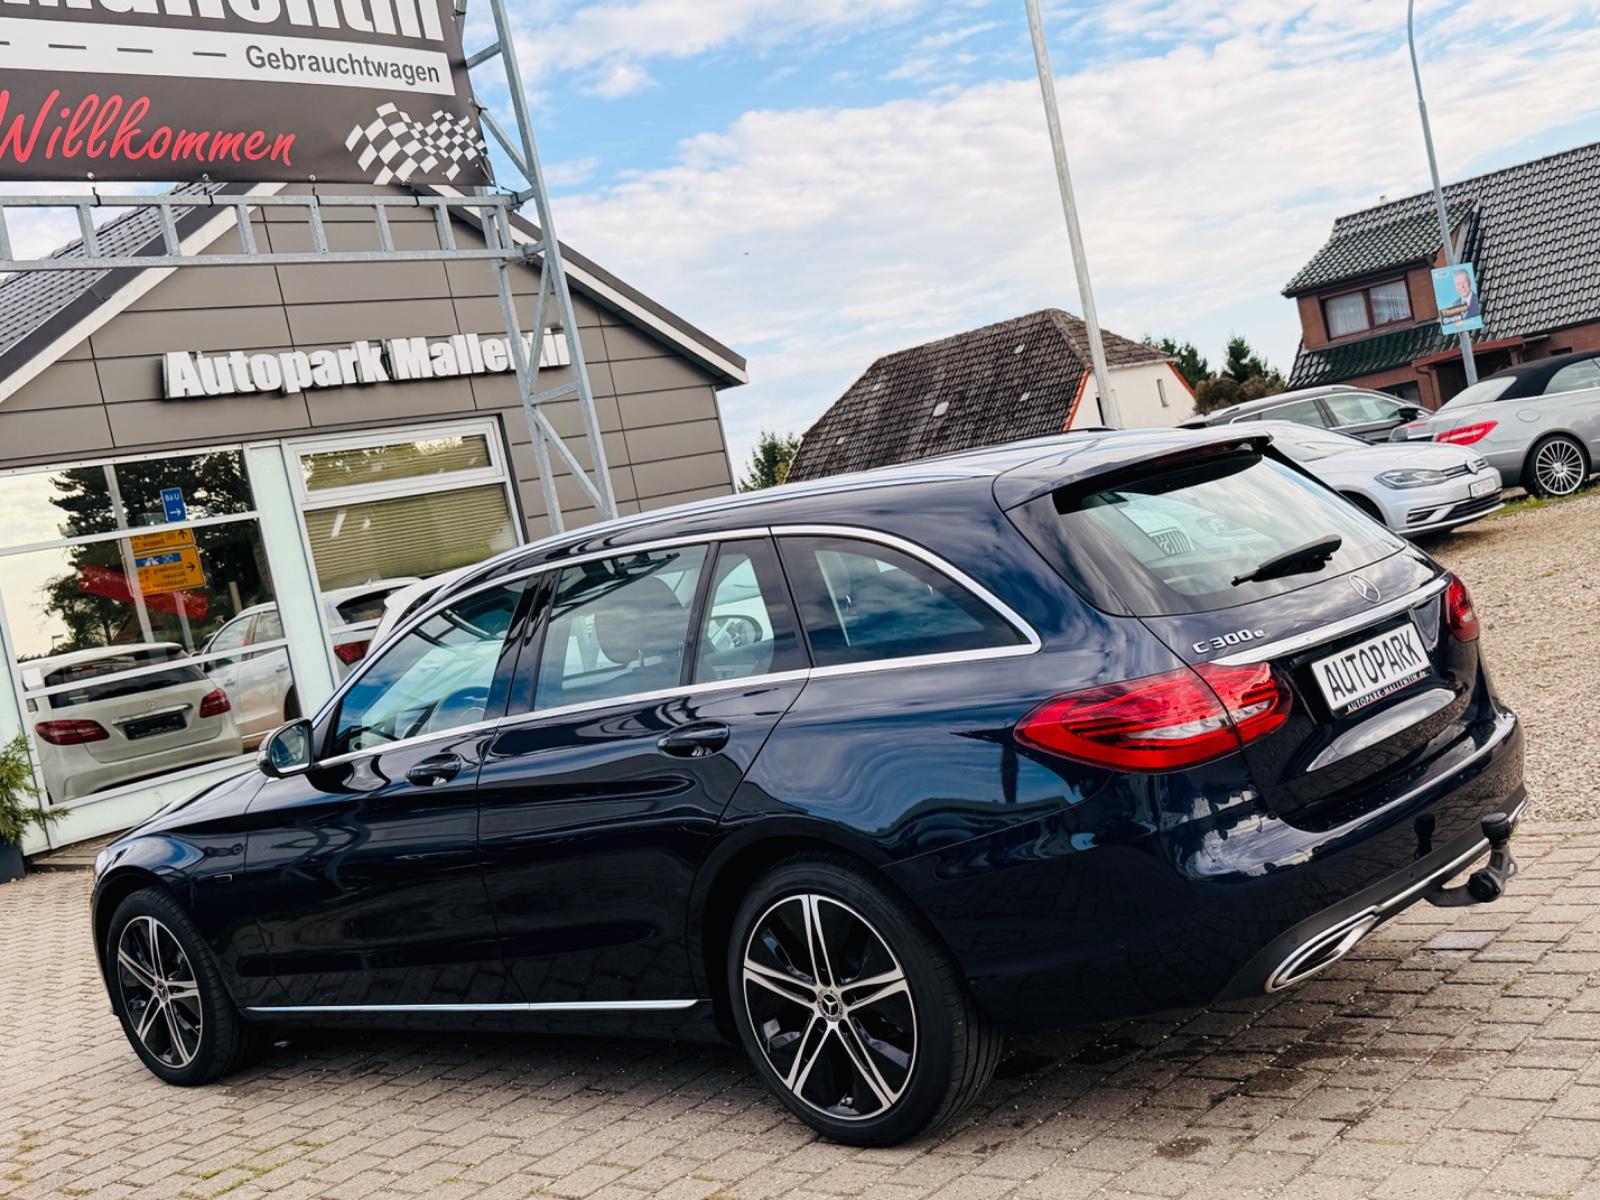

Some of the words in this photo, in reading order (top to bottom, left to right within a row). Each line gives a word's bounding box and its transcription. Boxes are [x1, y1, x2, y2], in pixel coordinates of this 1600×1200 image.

[245, 44, 440, 86] Gebrauchtwagen
[0, 89, 296, 167] Willkommen
[165, 340, 392, 398] Autopark
[1323, 630, 1423, 701] AUTOPARK
